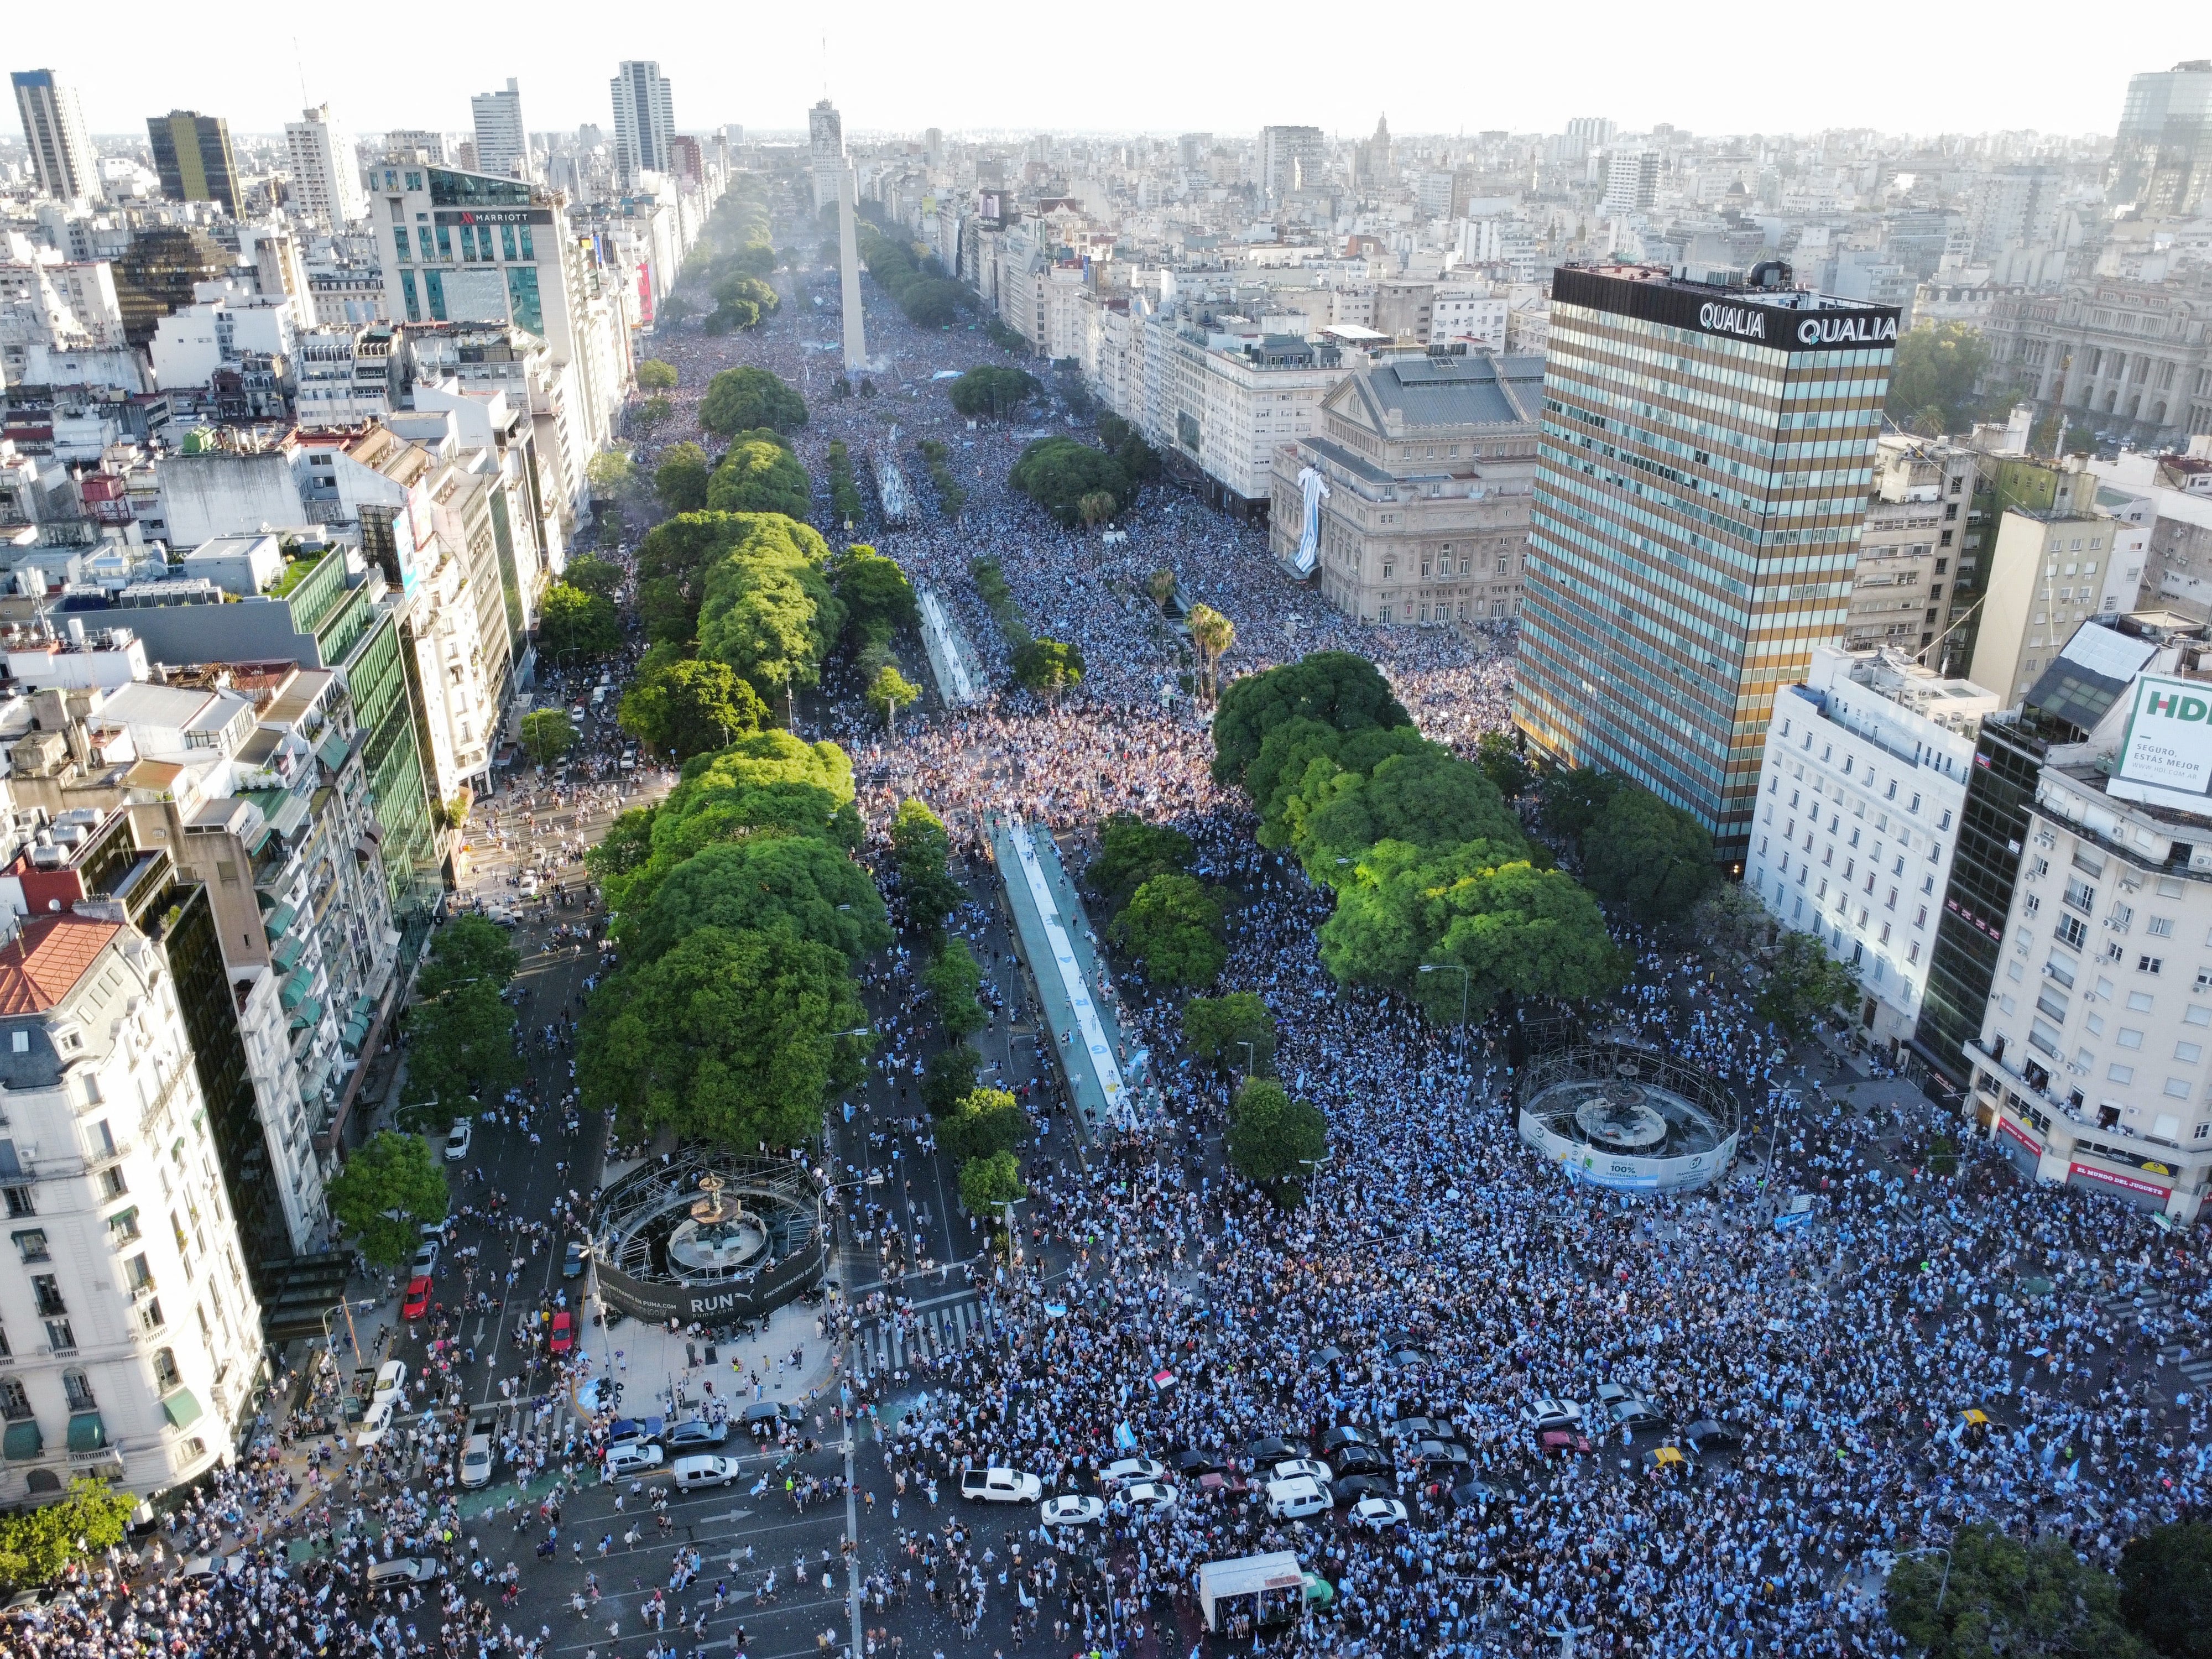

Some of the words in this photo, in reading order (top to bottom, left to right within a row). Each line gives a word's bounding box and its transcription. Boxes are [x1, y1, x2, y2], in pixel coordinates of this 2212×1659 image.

[1700, 302, 1765, 339] QUALIA
[1798, 317, 1897, 346] QUALIA
[2134, 753, 2163, 764] ESTÁS
[2167, 759, 2200, 771] MEJOR
[2137, 744, 2177, 758] SEGURO,
[1610, 1165, 1636, 1173] 100%
[2087, 1170, 2114, 1181] MUNDO
[2129, 1182, 2163, 1195] JUGUETE
[763, 1272, 805, 1299] ENCONTRANOS
[805, 1267, 812, 1275] EN
[600, 1279, 634, 1301] ENCONTRANOS
[643, 1301, 676, 1310] PUMA.COM
[691, 1293, 733, 1313] RUN
[692, 1307, 734, 1318] puma.com
